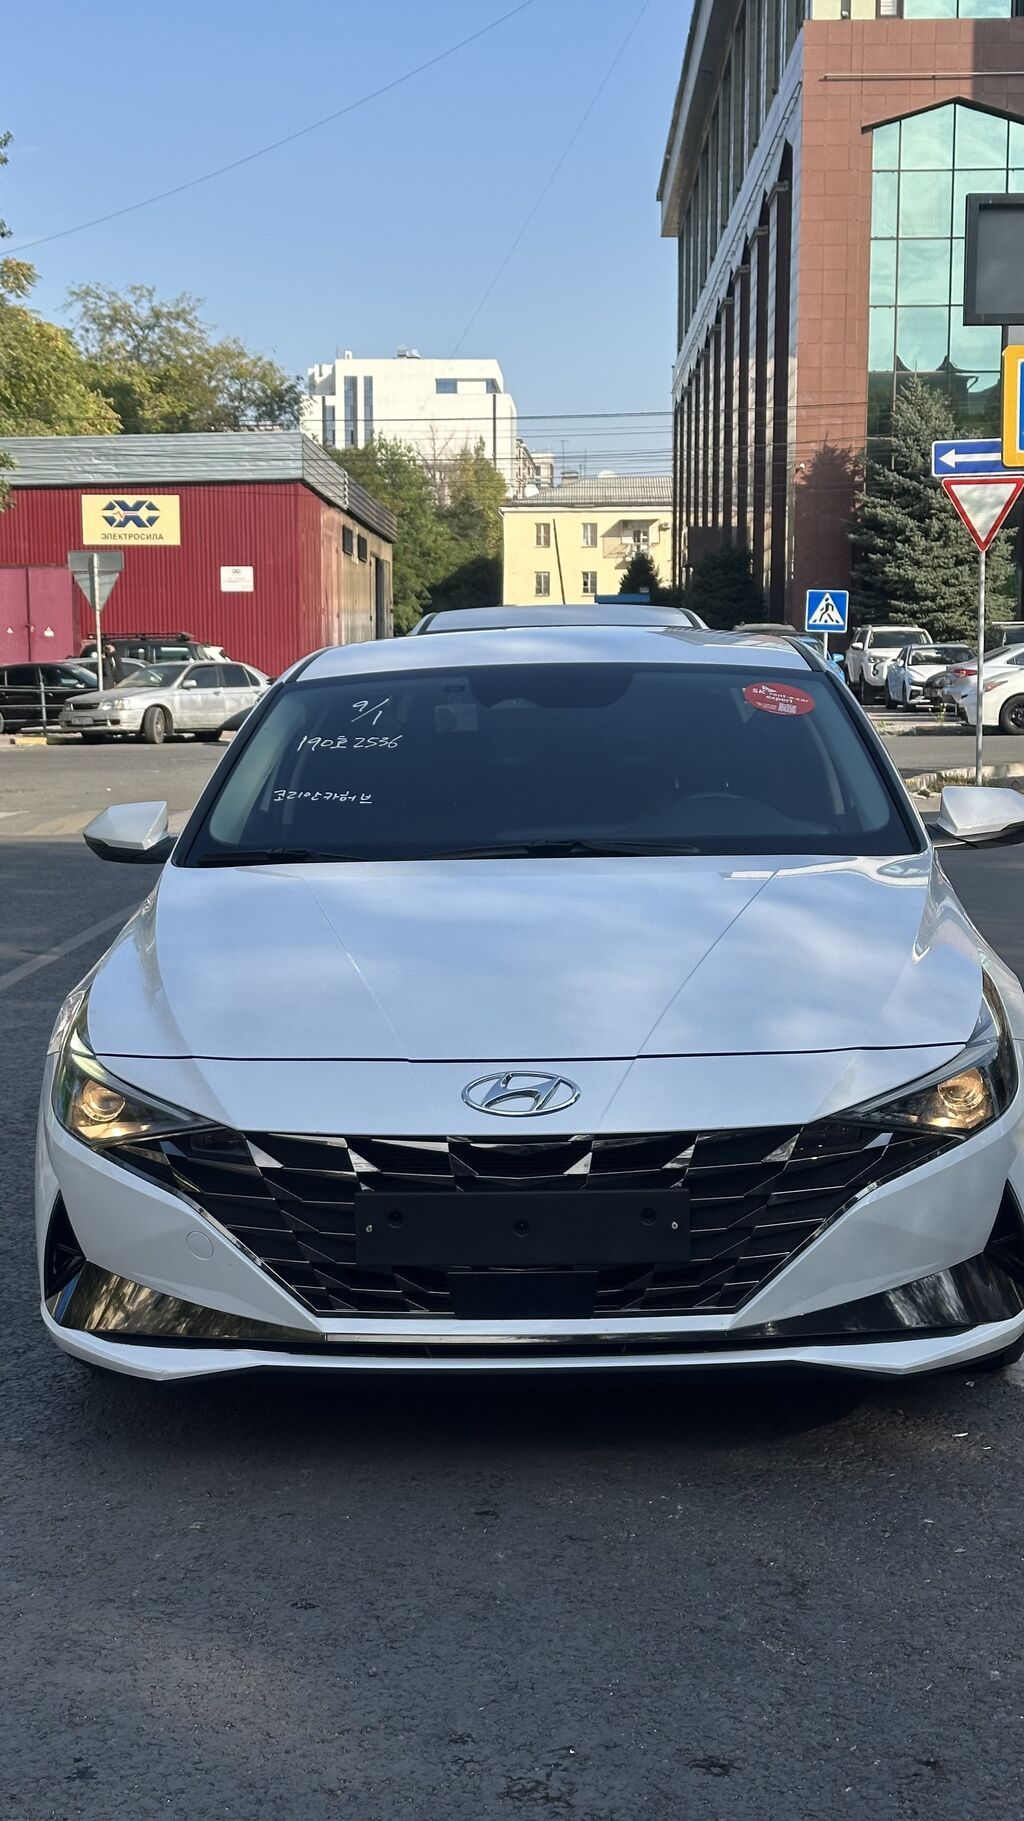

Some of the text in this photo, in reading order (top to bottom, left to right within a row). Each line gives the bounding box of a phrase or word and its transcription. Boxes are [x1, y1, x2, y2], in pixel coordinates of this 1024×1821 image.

[101, 533, 164, 541] ЭЛЕКТРОСИЛА
[766, 695, 793, 703] export
[351, 698, 390, 726] 9/1
[353, 735, 403, 748] 2536
